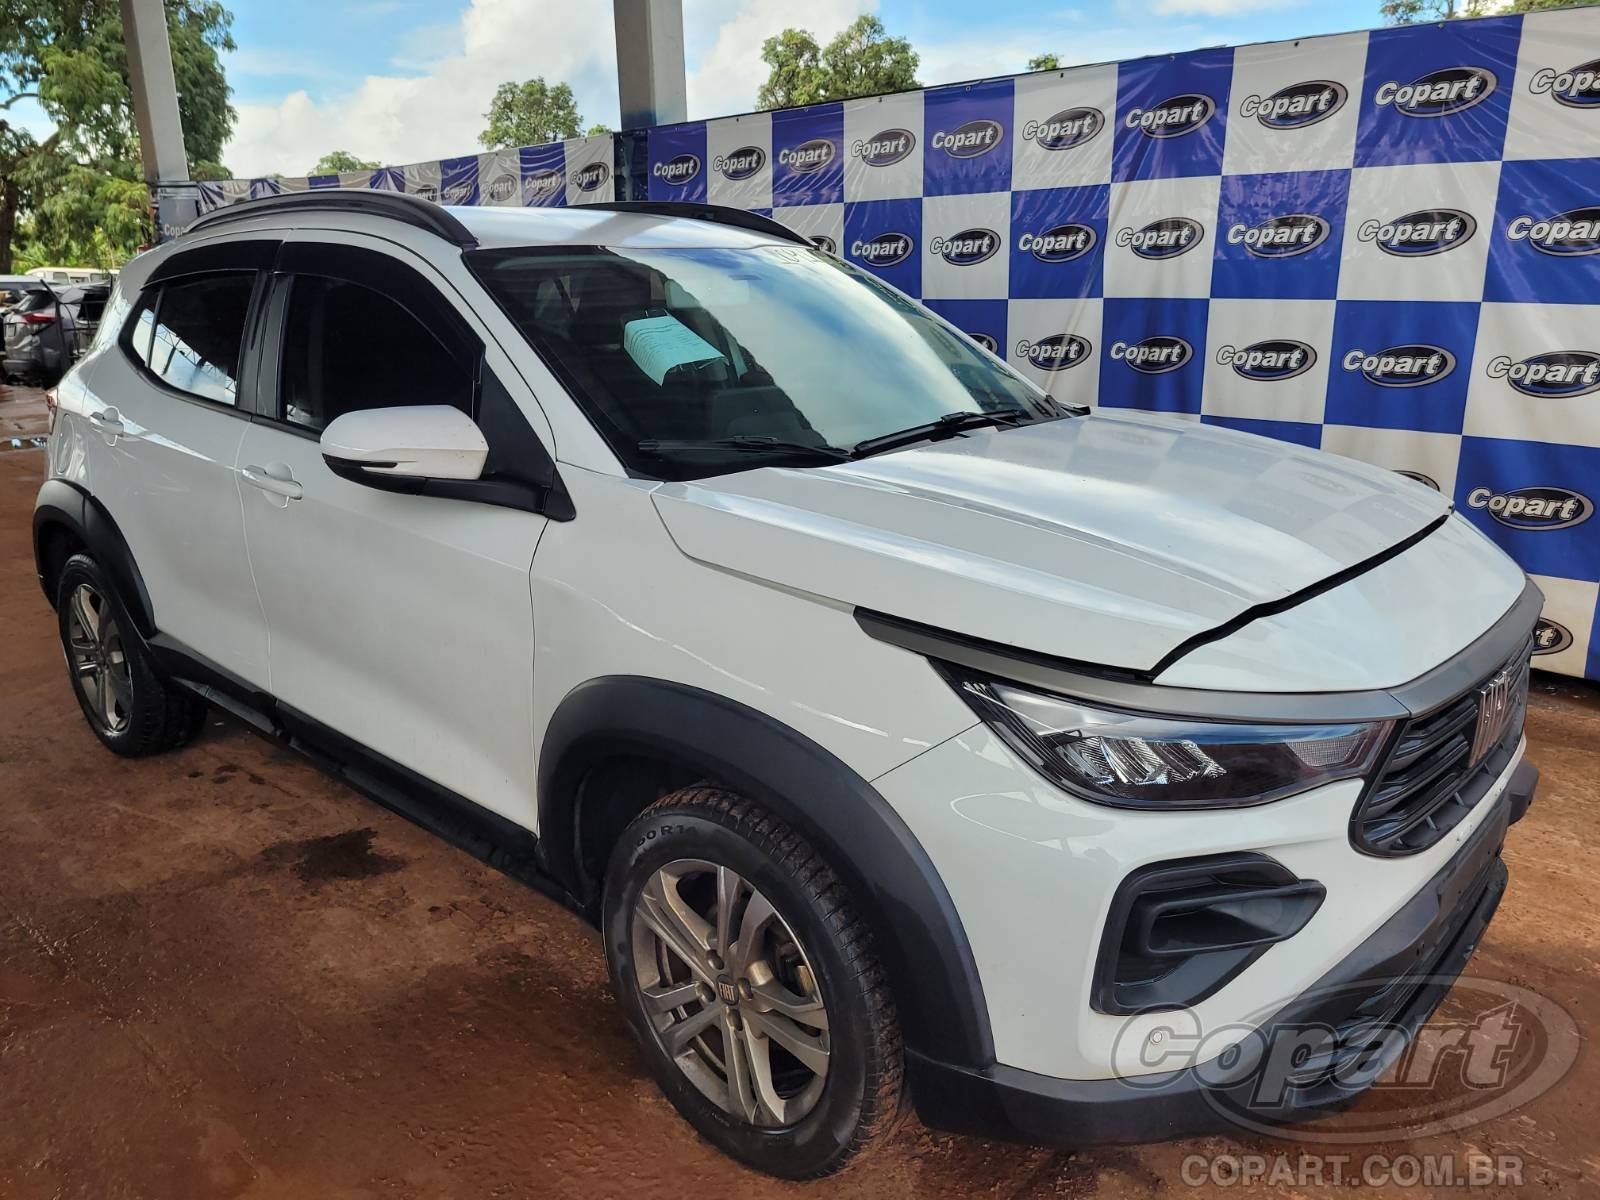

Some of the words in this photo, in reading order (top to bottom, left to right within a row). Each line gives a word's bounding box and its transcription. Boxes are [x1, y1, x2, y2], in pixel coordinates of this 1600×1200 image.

[1241, 87, 1333, 119] Copart
[1375, 72, 1482, 109] Copart
[1022, 113, 1093, 143] Copart
[1125, 100, 1203, 131] Copart
[851, 133, 907, 160] Copart
[932, 125, 996, 153] Copart
[713, 153, 761, 177] Copart
[779, 142, 830, 167] Copart
[570, 168, 604, 185] Copart
[653, 159, 695, 179] Copart
[525, 175, 557, 191] Copart
[1019, 230, 1086, 254] Copart
[1116, 223, 1191, 249] Copart
[1228, 221, 1316, 248] Copart
[1358, 216, 1461, 246] Copart
[851, 237, 905, 262] Copart
[930, 233, 992, 260] Copart
[1016, 340, 1080, 361] Copart
[1110, 341, 1182, 364] Copart
[1216, 345, 1302, 371] Copart
[1343, 350, 1443, 377] Copart
[1487, 355, 1600, 387] Copart
[1468, 486, 1578, 520] Copart
